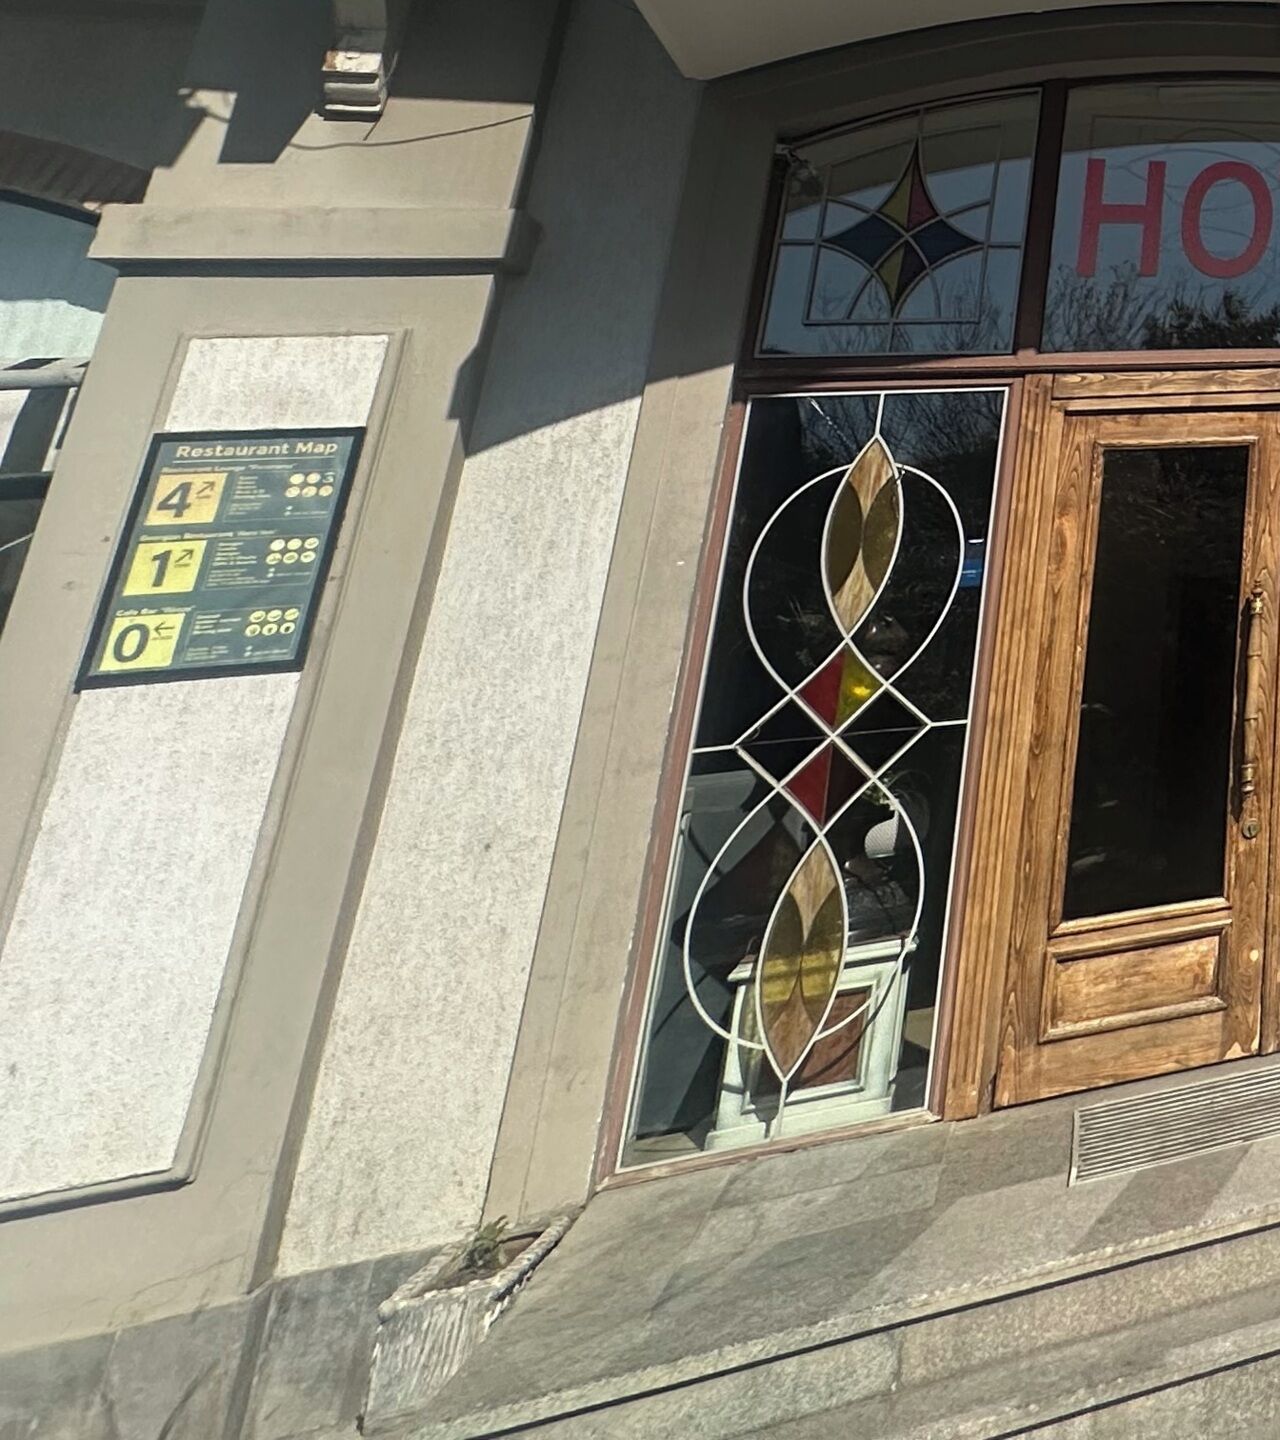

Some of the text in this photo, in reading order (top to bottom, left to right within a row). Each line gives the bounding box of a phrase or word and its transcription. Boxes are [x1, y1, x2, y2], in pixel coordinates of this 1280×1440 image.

[176, 441, 338, 458] Restaurant Map
[157, 480, 193, 518] 4
[152, 550, 172, 588] 1
[113, 623, 150, 664] 0
